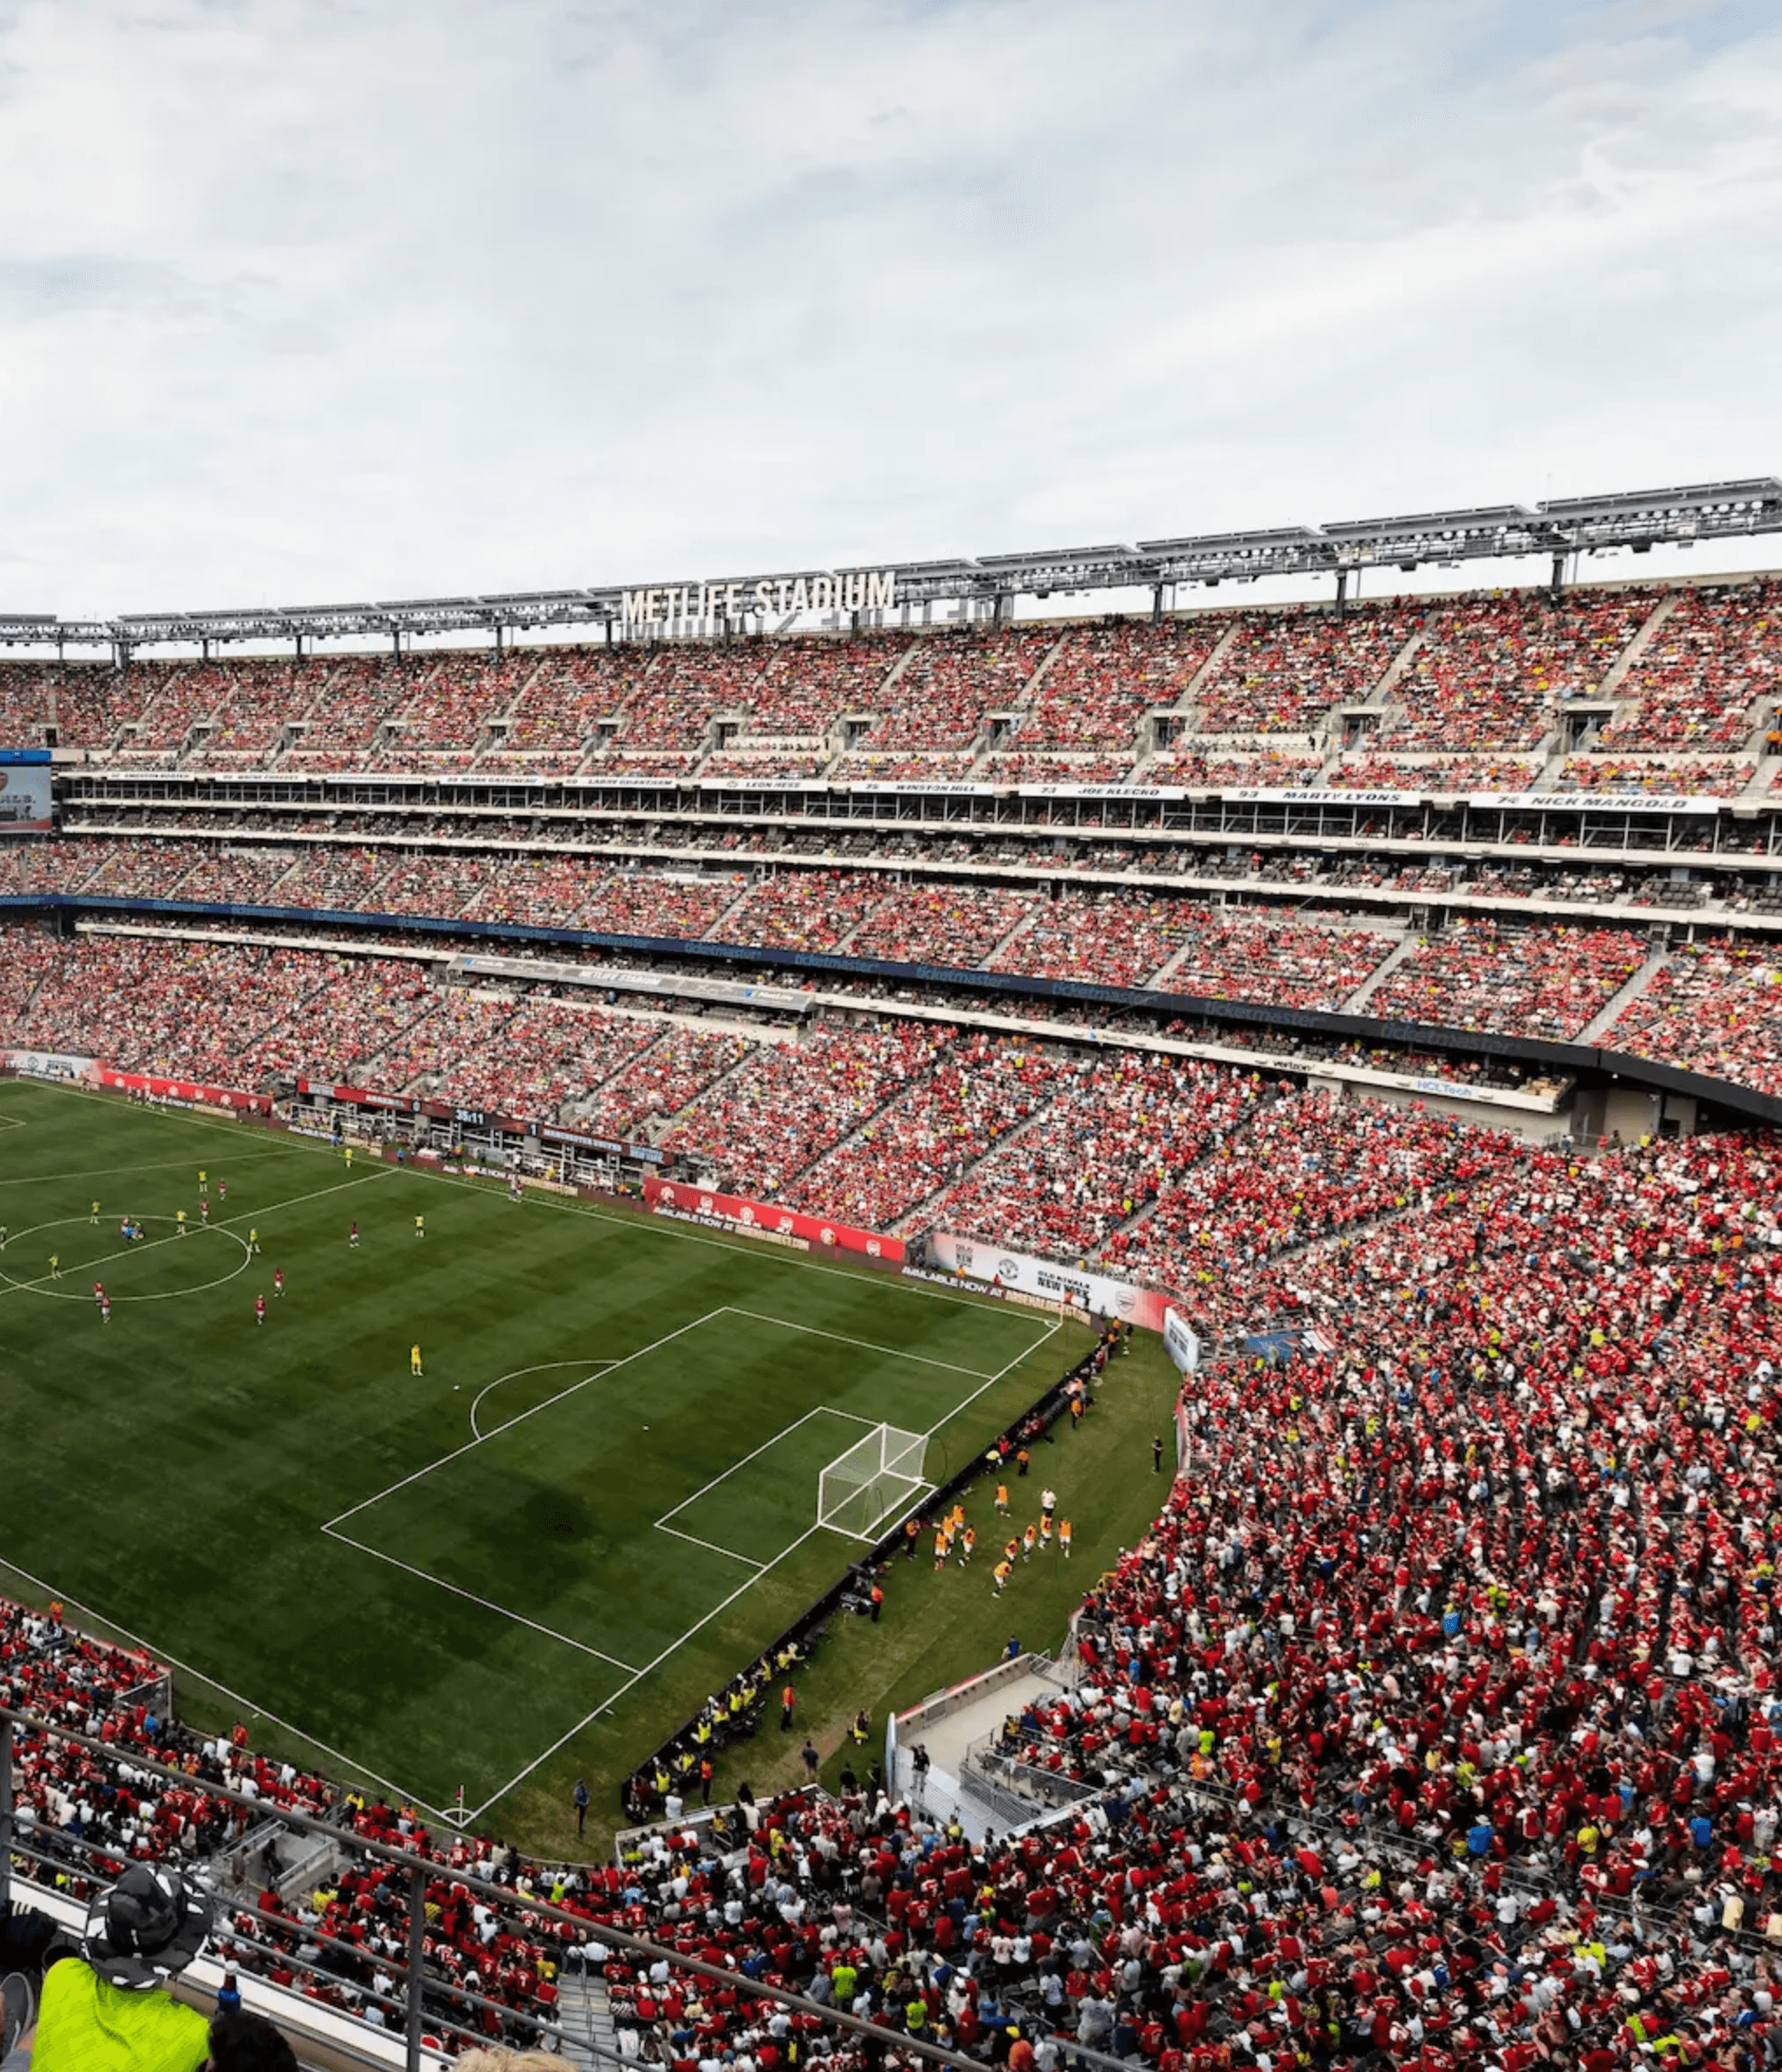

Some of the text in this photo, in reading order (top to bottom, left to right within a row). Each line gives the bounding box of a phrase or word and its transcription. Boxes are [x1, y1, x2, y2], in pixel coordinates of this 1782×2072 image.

[621, 582, 745, 626] METLIFE
[754, 570, 895, 616] STADIUM
[1238, 790, 1402, 802] 93 MARTY LYONS
[1531, 796, 1580, 807] NICK
[1582, 797, 1688, 808] MANGOLD
[916, 965, 1010, 987] ticketmaster
[1052, 981, 1157, 1006] ticketmaster
[1204, 1000, 1324, 1029] ticketmaster
[1273, 1060, 1311, 1073] verizon
[1416, 1080, 1472, 1097] HCLTech
[700, 1216, 722, 1229] NOW
[901, 1265, 959, 1287] AVAILABLE
[959, 1280, 989, 1295] NOW
[989, 1286, 1004, 1298] AT
[1037, 1269, 1055, 1280] OLD
[1037, 1277, 1062, 1292] NEW
